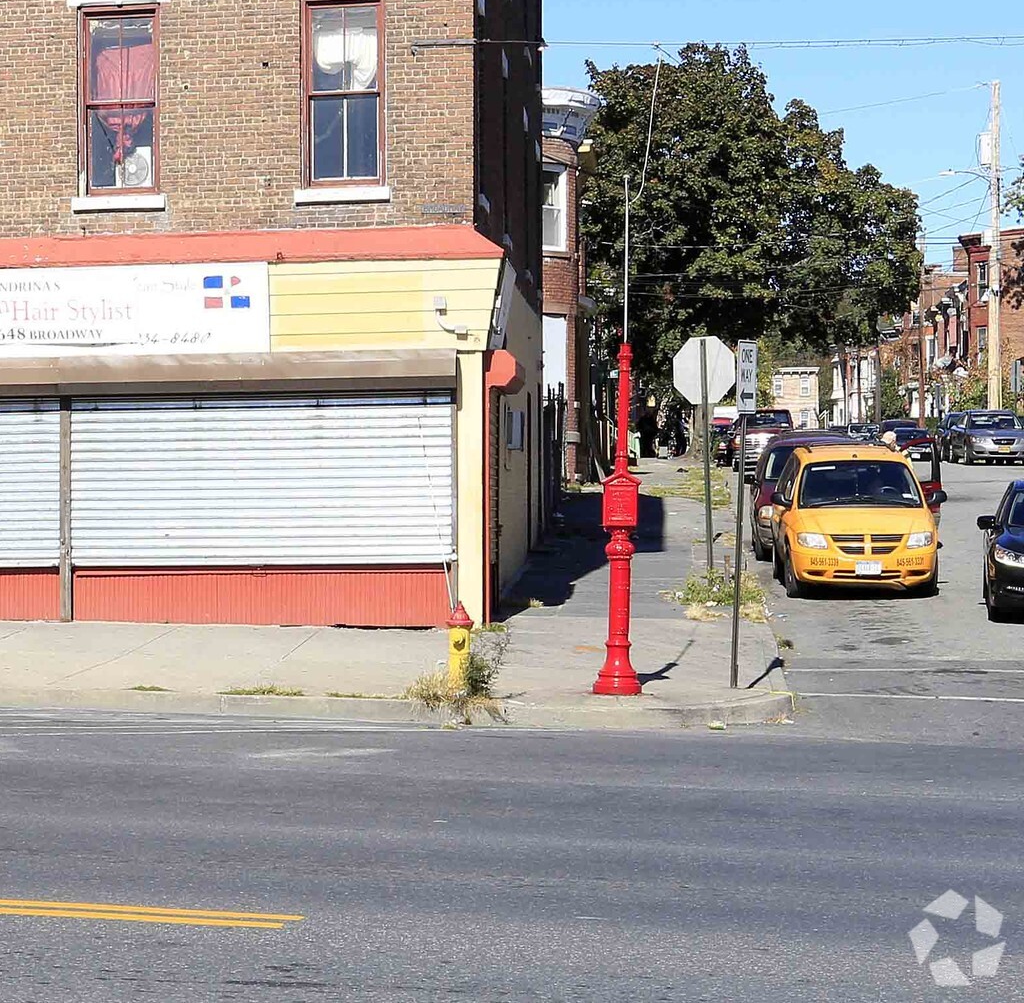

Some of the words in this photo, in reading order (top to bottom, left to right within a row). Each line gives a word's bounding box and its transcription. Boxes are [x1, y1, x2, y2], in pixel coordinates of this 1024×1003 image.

[12, 300, 59, 321] Hair
[66, 298, 132, 325] Stylist
[29, 328, 103, 341] BROADWAY
[741, 348, 754, 364] ONE
[740, 368, 754, 383] WAY
